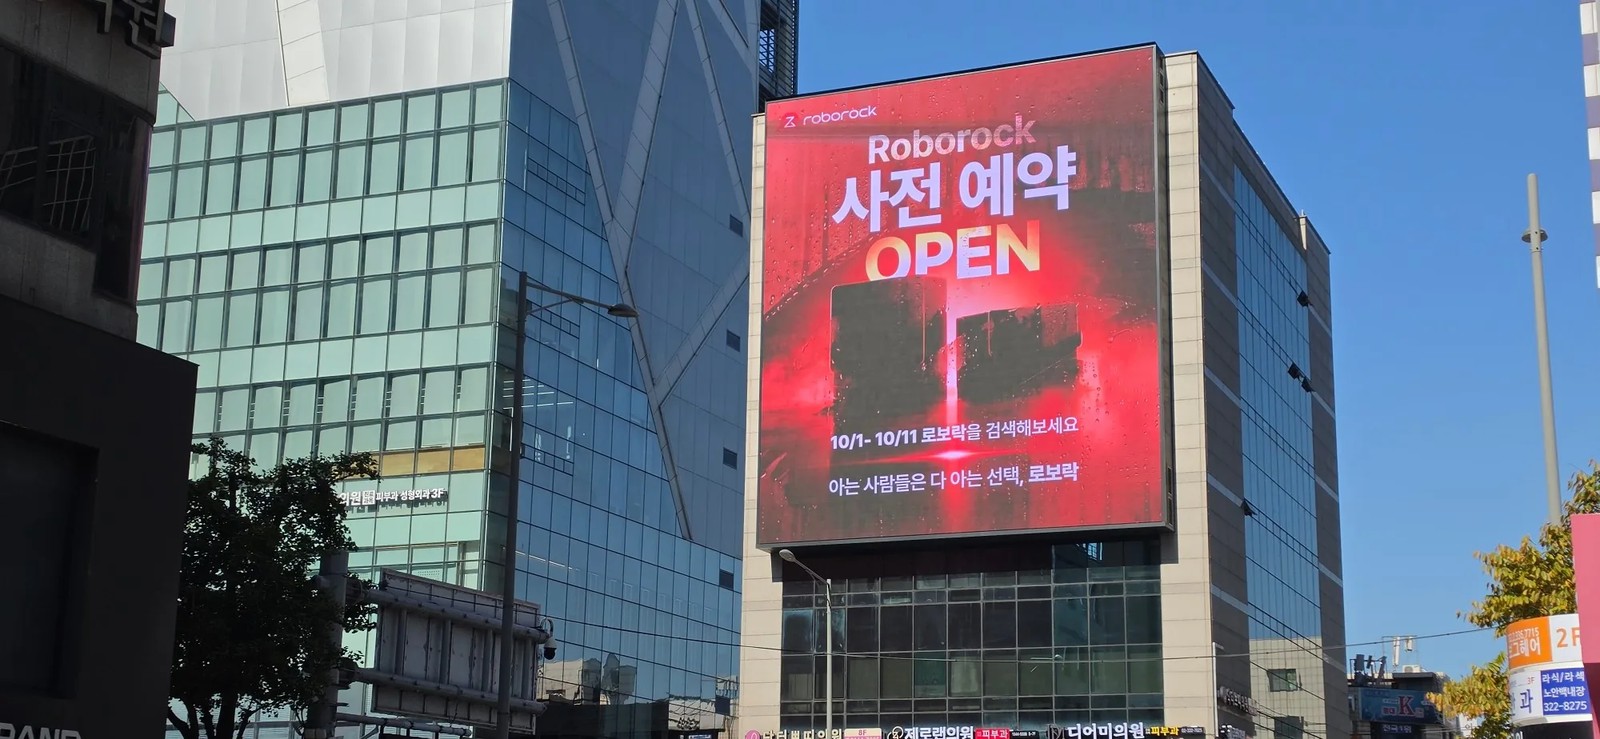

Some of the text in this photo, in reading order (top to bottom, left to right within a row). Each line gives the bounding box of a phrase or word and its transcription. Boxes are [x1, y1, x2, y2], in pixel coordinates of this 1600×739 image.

[803, 105, 877, 127] roborock
[868, 113, 1037, 165] Roborock
[832, 145, 1077, 232] 사전 예약
[865, 220, 1040, 282] OPEN
[875, 430, 917, 448] 10/11
[921, 424, 981, 443] 로보락을
[986, 417, 1079, 439] 검색해보세요
[829, 462, 1080, 497] 아는 사람들은 다 아는 선택, 로보락
[376, 491, 398, 502] 피부과
[400, 489, 431, 501] 성형외과
[1556, 626, 1580, 648] 2F
[1543, 701, 1588, 712] 322-8275
[1067, 723, 1145, 739] 디어미의원
[1151, 726, 1179, 736] 피부과
